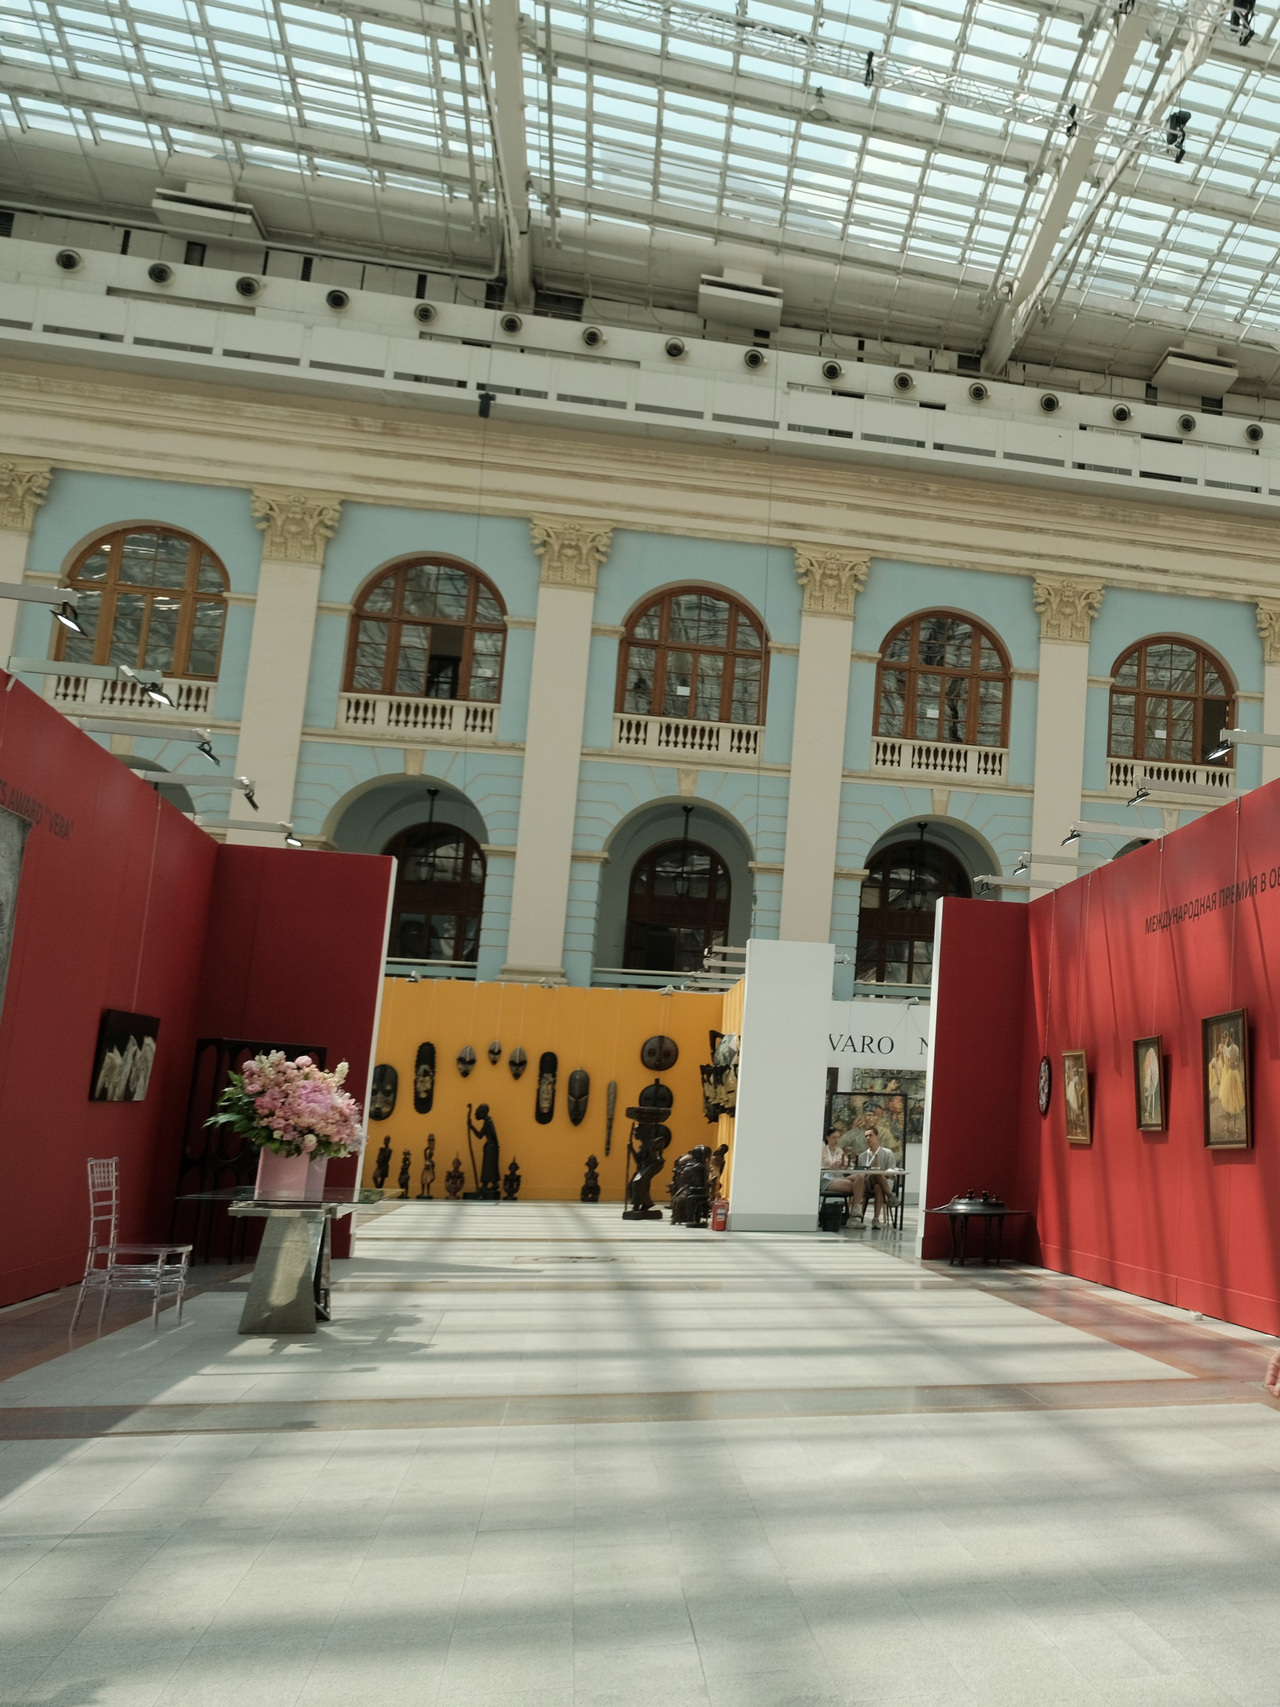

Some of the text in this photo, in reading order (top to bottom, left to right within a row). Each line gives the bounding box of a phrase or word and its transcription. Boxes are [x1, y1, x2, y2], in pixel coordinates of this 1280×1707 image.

[1144, 892, 1217, 935] МЕЖДУНАРОДНАЯ
[1218, 876, 1258, 909] ПРЕМИЯ
[1260, 872, 1267, 893] В
